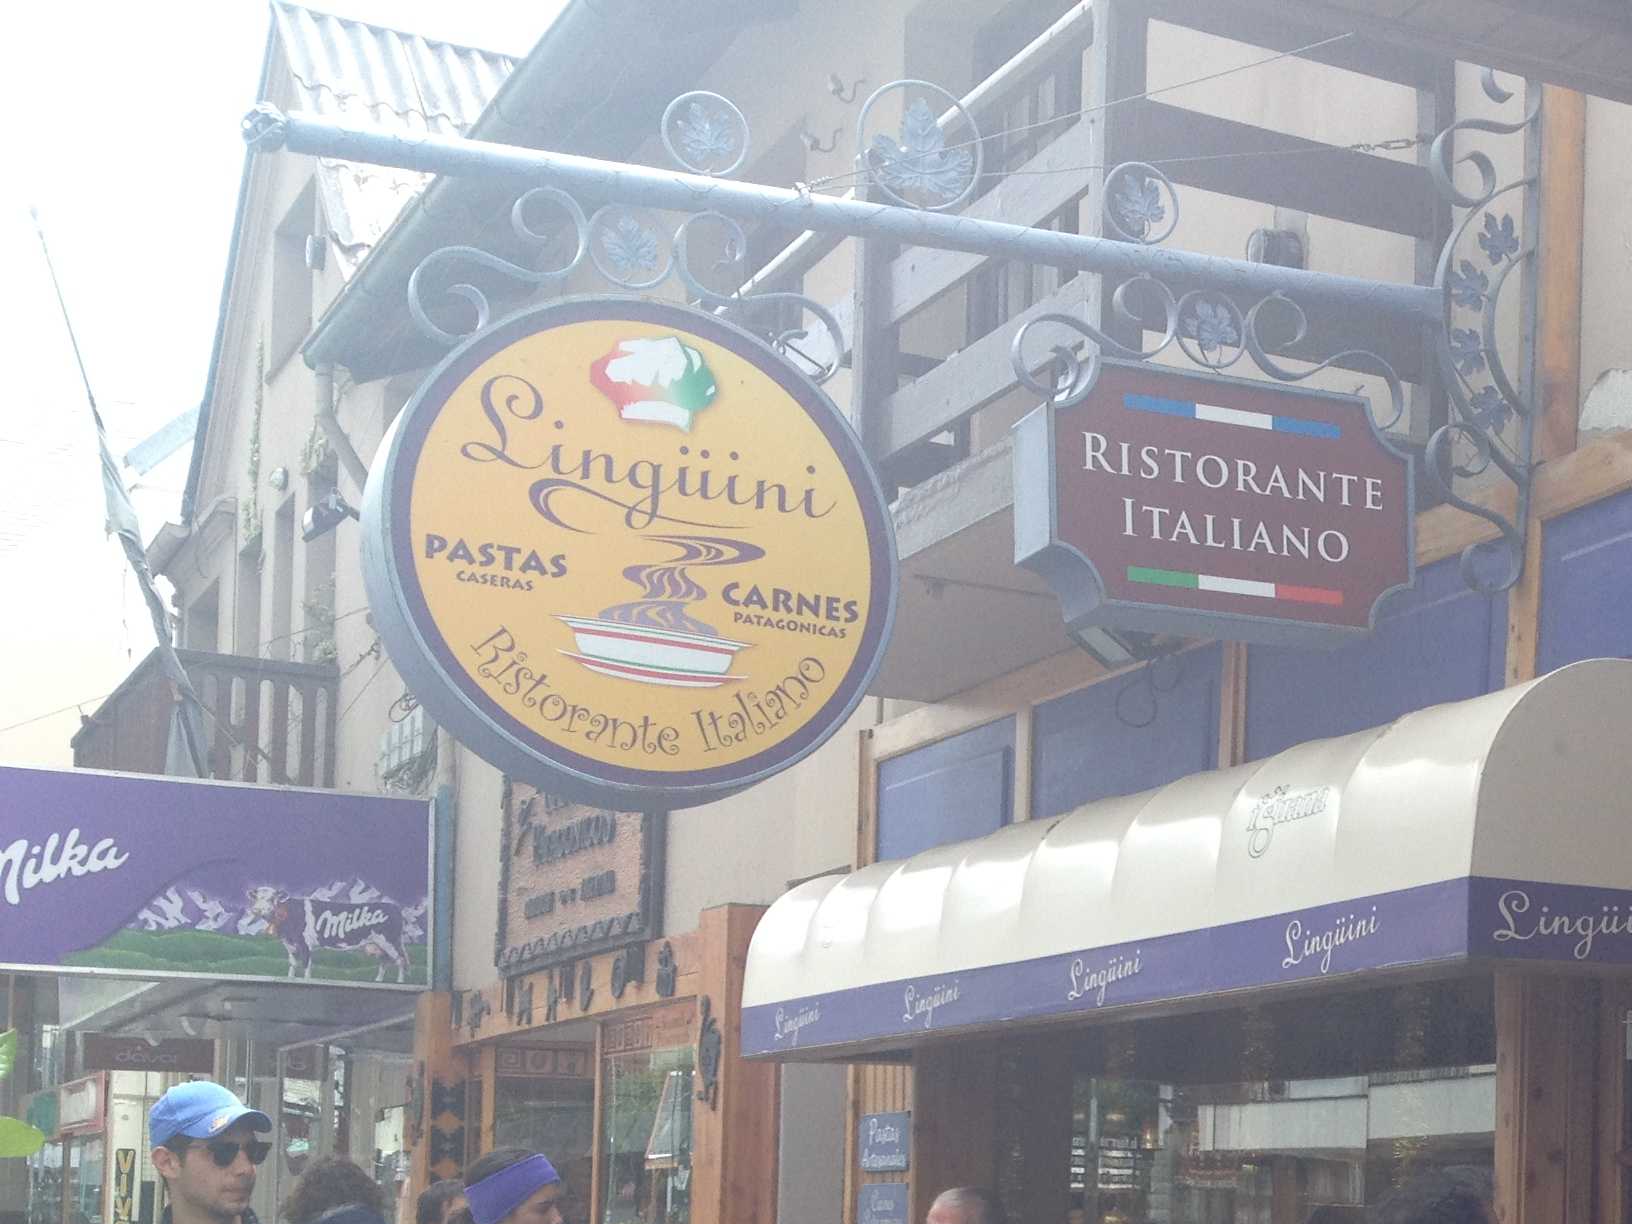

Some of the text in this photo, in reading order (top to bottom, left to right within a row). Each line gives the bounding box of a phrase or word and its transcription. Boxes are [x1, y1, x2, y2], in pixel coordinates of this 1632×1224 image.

[1081, 431, 1384, 511] RISTORANTE
[1121, 497, 1350, 563] ITALIANO
[424, 533, 568, 579] PASTAS
[455, 570, 534, 592] CASERAS
[721, 581, 860, 625] CARNES
[733, 611, 848, 640] PATAGONICAS
[470, 624, 826, 756] Ristorante Italiano
[316, 905, 389, 939] Milka
[1281, 905, 1381, 974] Lingüini
